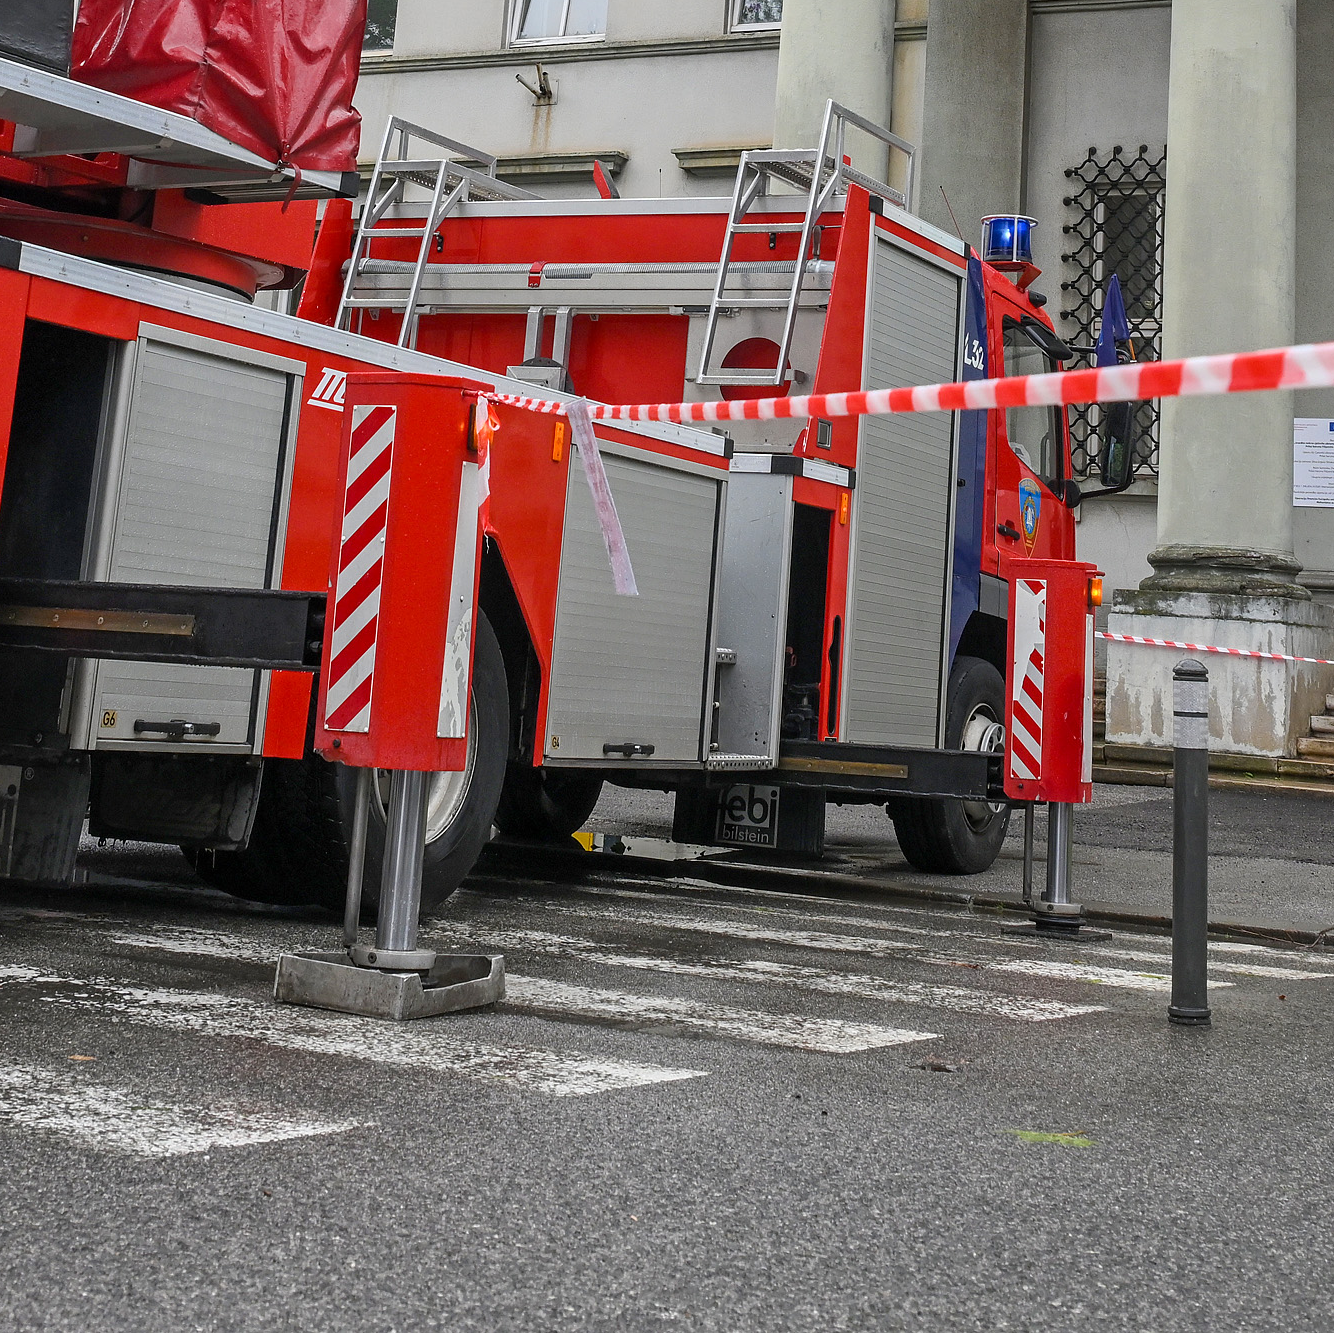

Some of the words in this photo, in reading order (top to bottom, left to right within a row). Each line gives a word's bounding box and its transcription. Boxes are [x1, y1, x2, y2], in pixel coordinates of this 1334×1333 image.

[964, 332, 985, 371] L32
[102, 711, 116, 726] G6
[722, 824, 769, 844] bilstein
